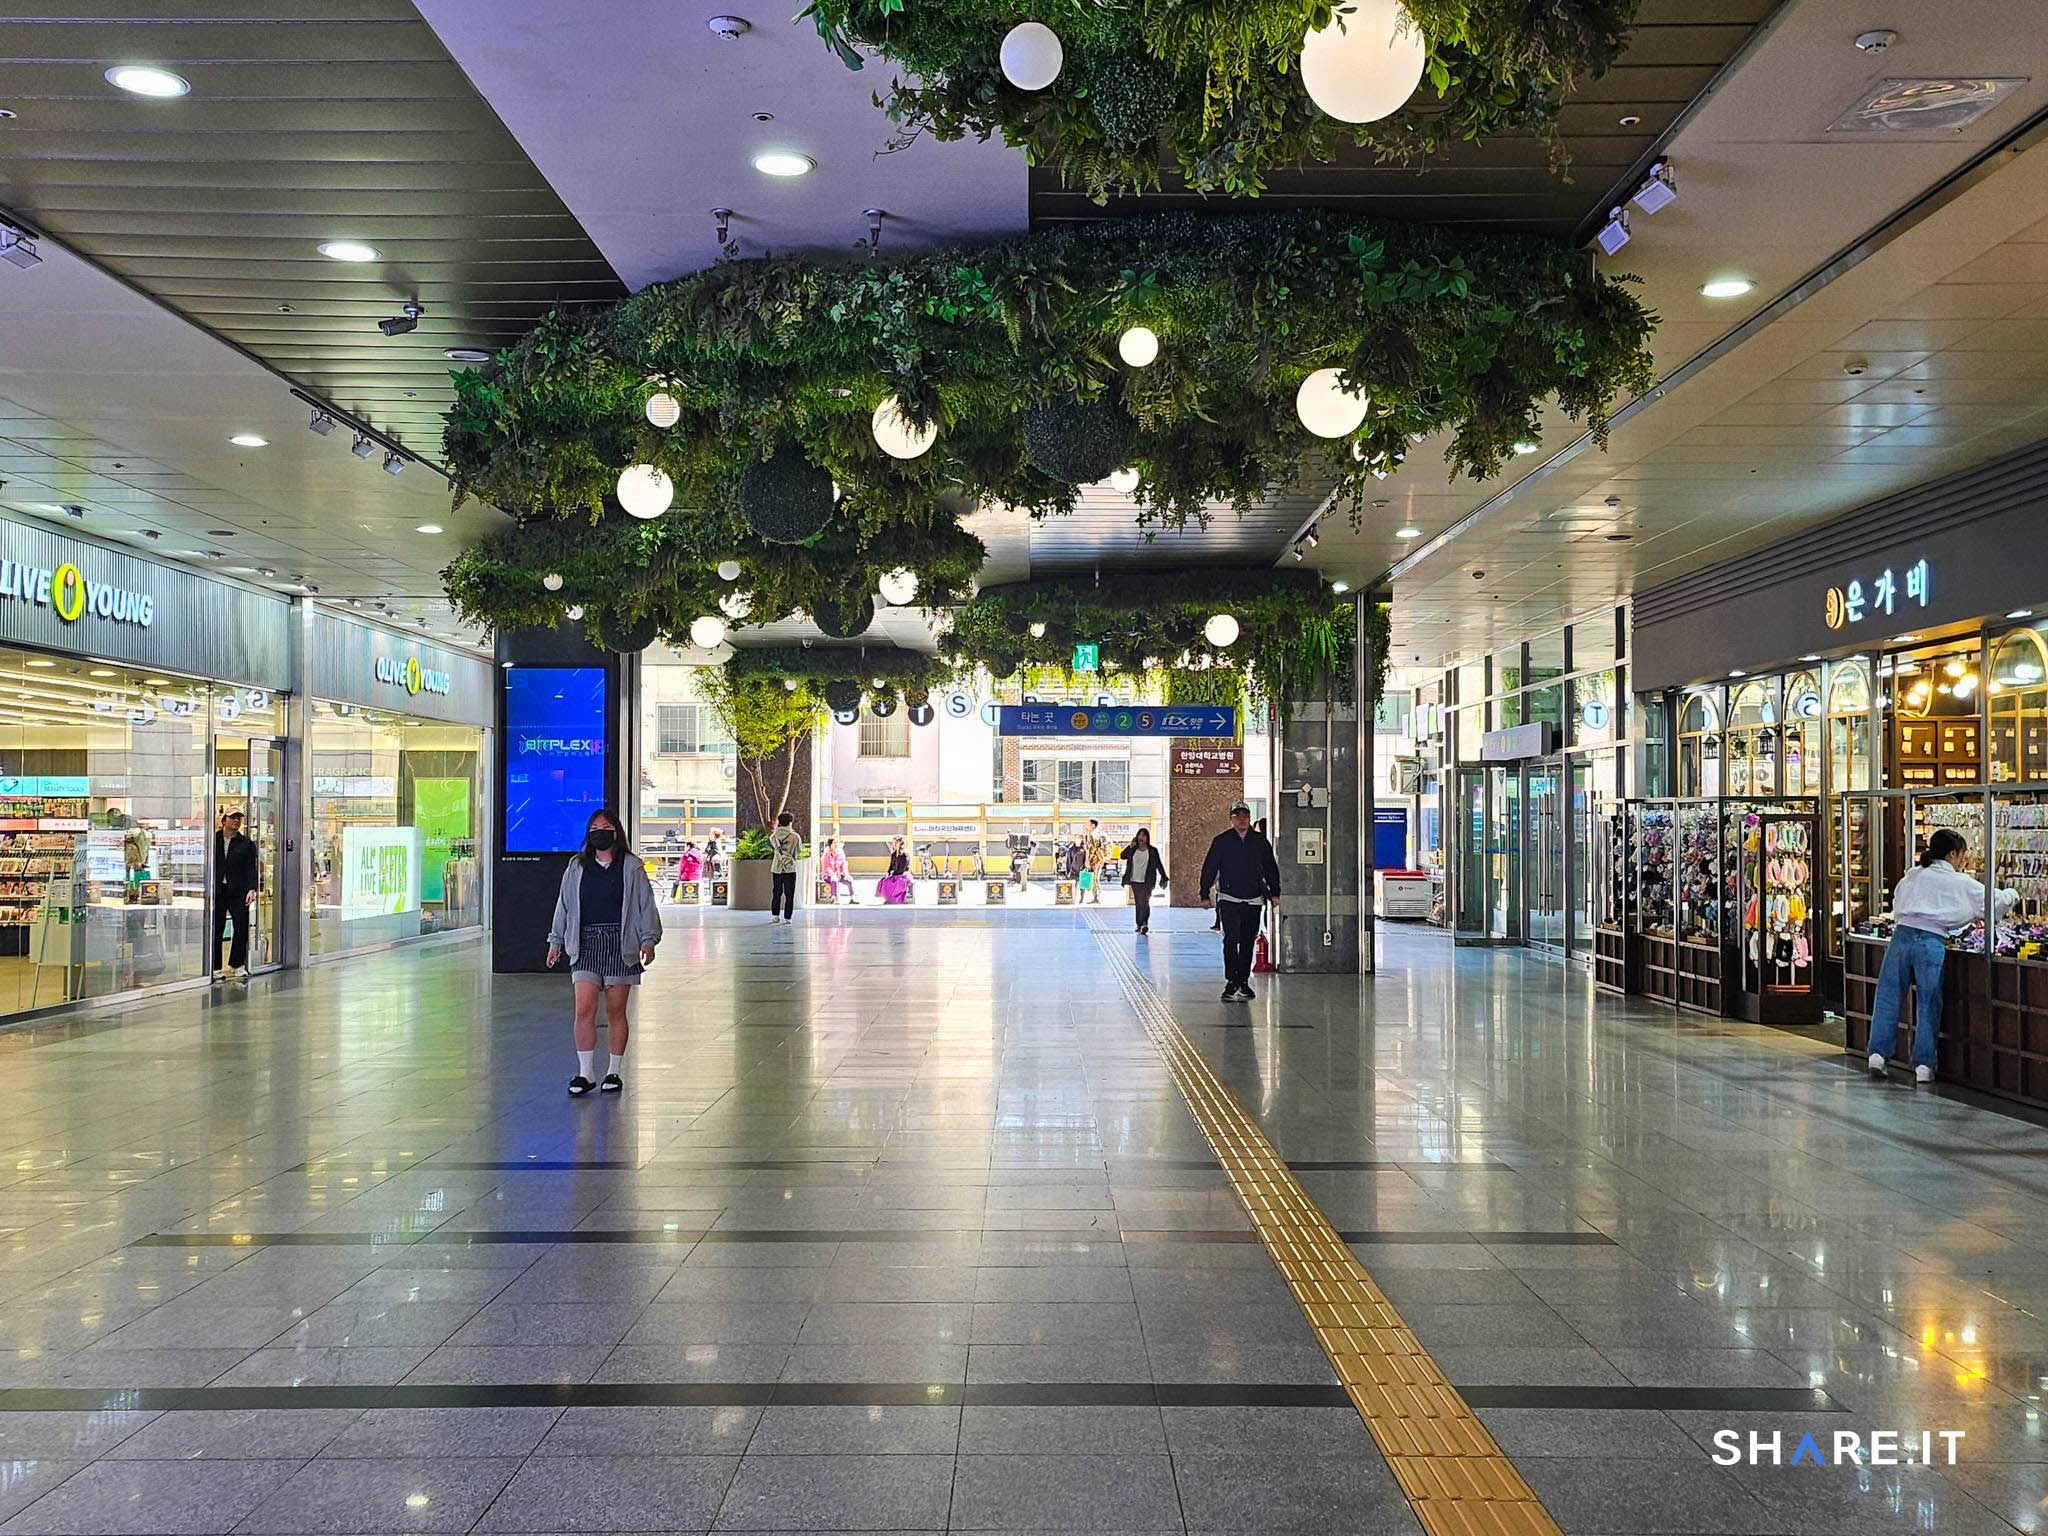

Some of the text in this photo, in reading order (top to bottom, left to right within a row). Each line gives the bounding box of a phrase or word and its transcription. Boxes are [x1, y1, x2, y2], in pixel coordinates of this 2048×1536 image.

[1845, 559, 1927, 622] 은가비
[86, 580, 154, 627] YOUNG
[377, 656, 450, 695] OLIVE YOUNG
[1021, 712, 1053, 722] 타는 곳
[1120, 715, 1127, 726] 2
[1141, 715, 1149, 726] 5
